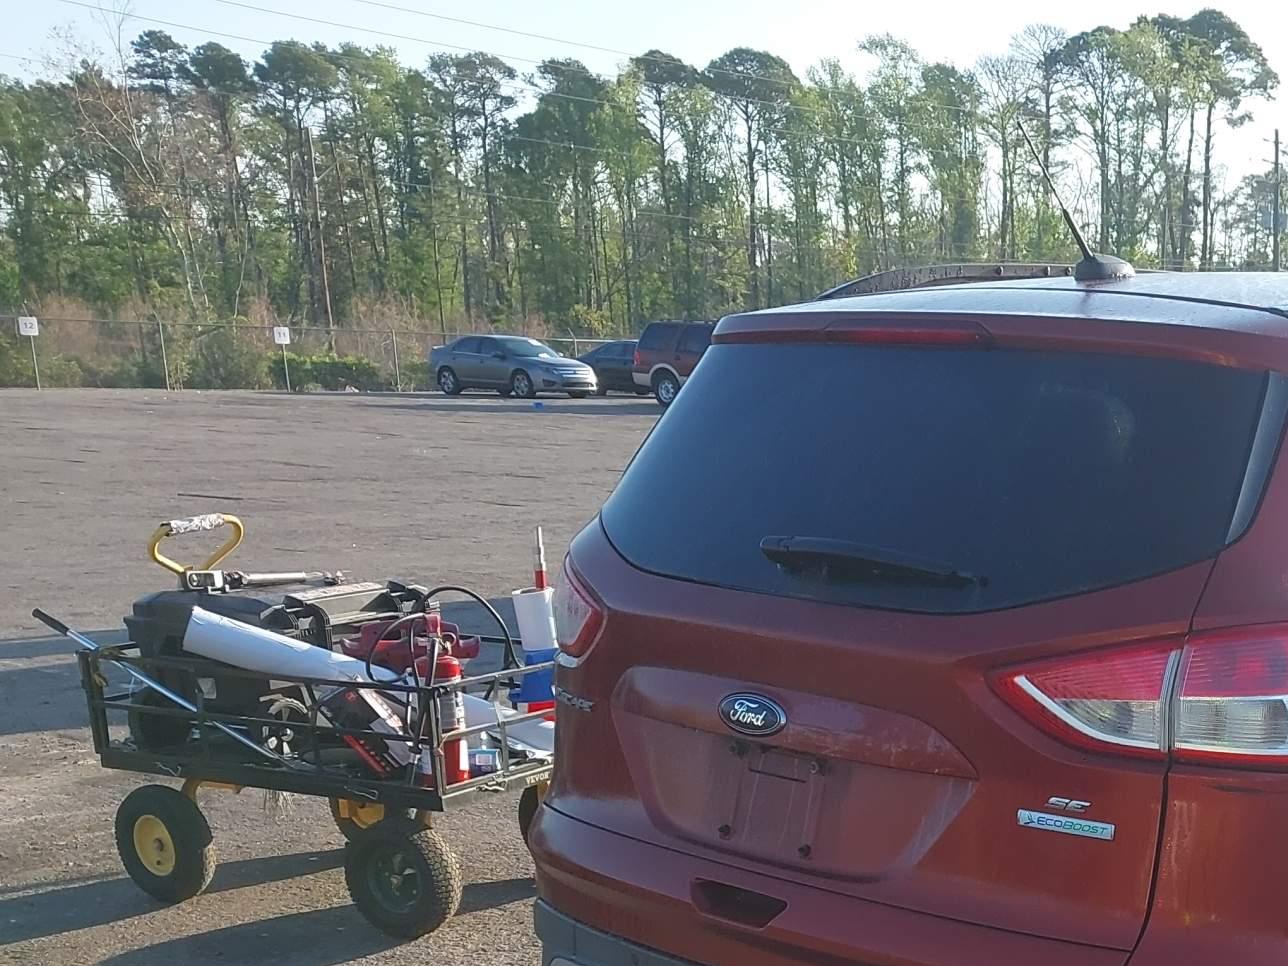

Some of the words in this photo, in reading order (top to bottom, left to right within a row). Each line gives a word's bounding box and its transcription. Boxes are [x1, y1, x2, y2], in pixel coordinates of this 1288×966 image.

[23, 322, 34, 330] 12
[730, 700, 767, 726] Ford
[1044, 796, 1092, 813] SE
